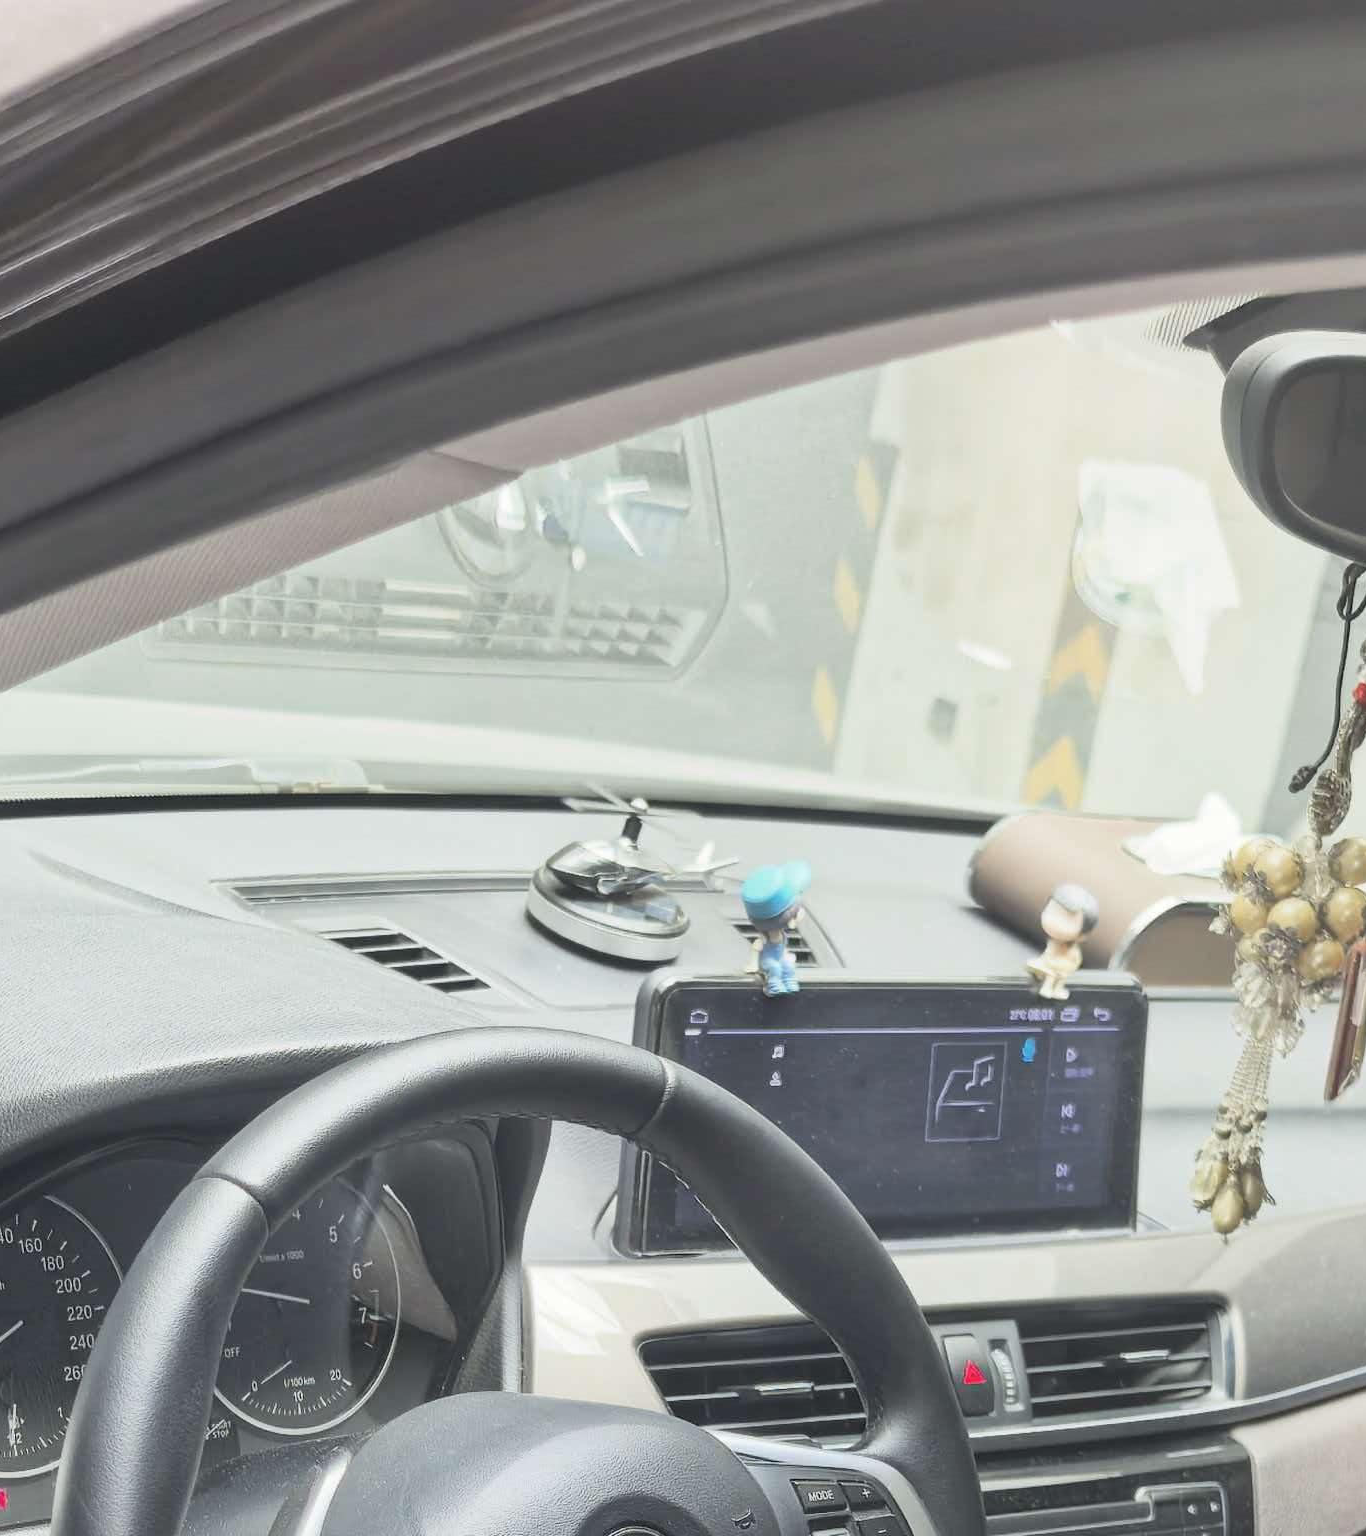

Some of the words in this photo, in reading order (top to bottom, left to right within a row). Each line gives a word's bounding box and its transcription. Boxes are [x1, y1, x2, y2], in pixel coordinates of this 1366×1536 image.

[329, 1225, 338, 1243] 5
[18, 1238, 43, 1254] 160
[41, 1255, 65, 1272] 180
[352, 1262, 362, 1280] 6
[55, 1277, 82, 1294] 200
[67, 1304, 92, 1322] 220
[358, 1306, 367, 1325] 7
[69, 1333, 95, 1350] 240
[329, 1368, 342, 1381] 20
[251, 1380, 259, 1393] 0
[293, 1391, 305, 1403] 10
[808, 1489, 835, 1502] MODE
